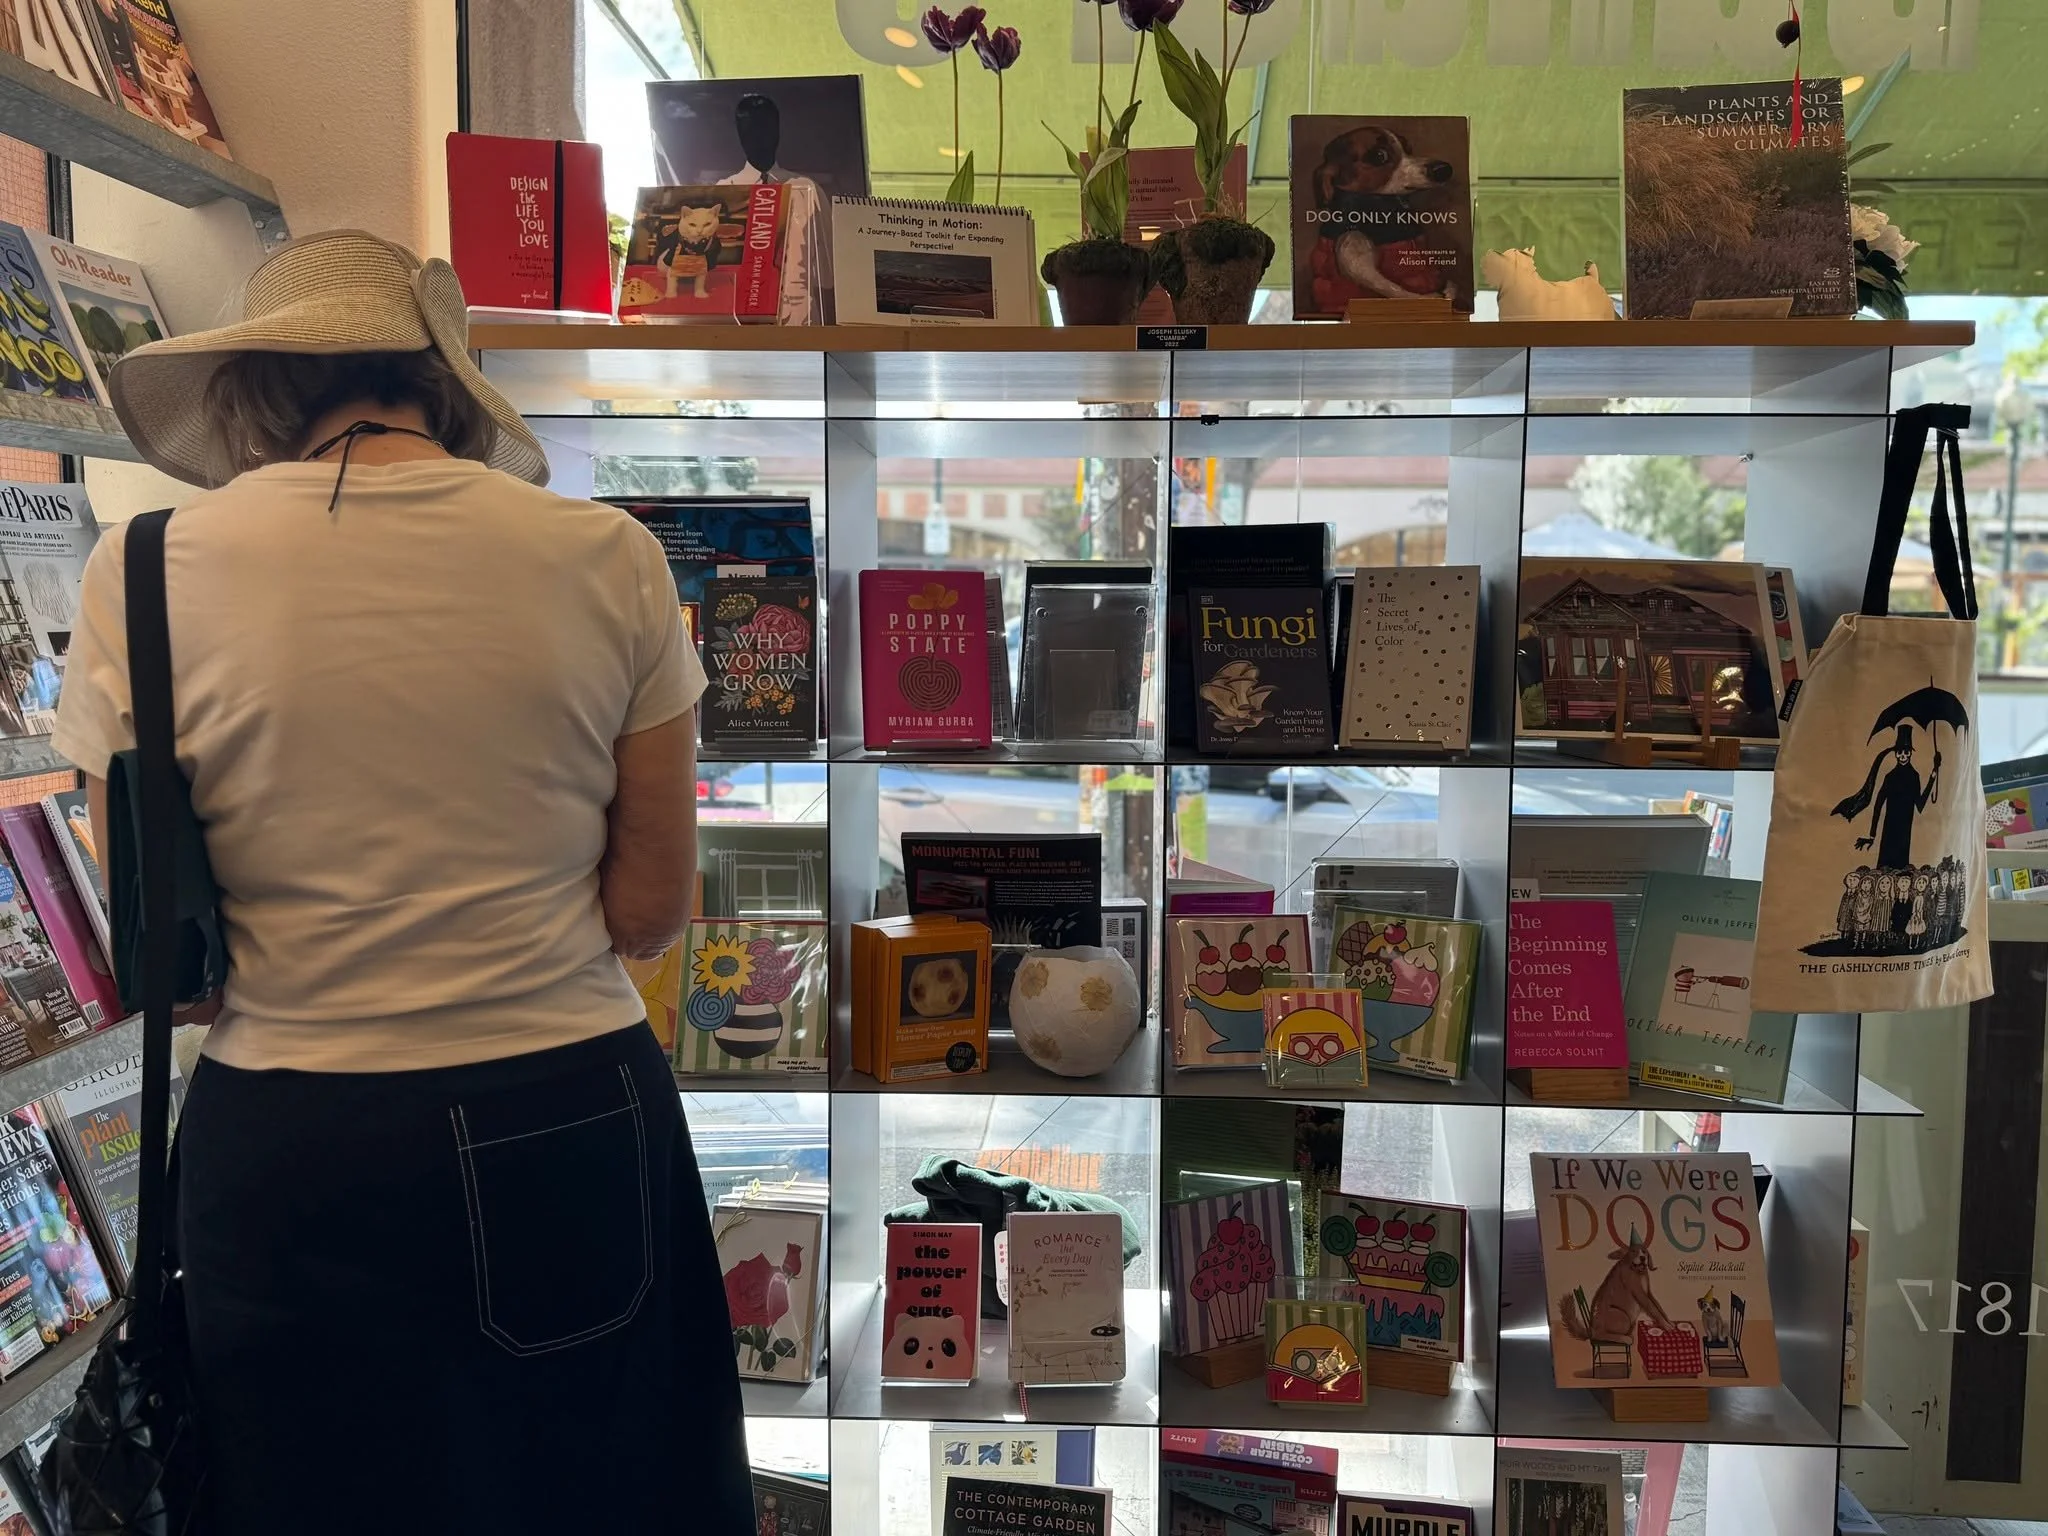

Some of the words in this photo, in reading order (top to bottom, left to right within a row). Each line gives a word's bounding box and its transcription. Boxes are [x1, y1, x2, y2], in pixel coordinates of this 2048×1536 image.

[1708, 95, 1779, 110] PLANTS
[1662, 109, 1785, 126] LANDSCAPES
[1802, 107, 1831, 119] OR
[510, 175, 548, 192] DESIGN
[519, 192, 536, 204] the
[515, 204, 540, 218] LIFE
[752, 187, 777, 250] CATLAND
[1306, 210, 1344, 224] DOG
[1348, 210, 1393, 225] ONLY
[1397, 211, 1458, 225] KNOWS
[519, 218, 545, 234] YOU
[878, 213, 924, 229] Thinking
[928, 215, 938, 228] in
[942, 217, 983, 230] Motion:
[519, 233, 550, 249] LOVE
[866, 227, 923, 239] Journey-Based
[926, 231, 951, 240] Toolkit
[953, 232, 966, 241] for
[968, 233, 1005, 246] Expanding
[910, 240, 954, 252] Perspective!
[50, 244, 78, 271] Oh
[76, 253, 132, 287] Reader
[752, 255, 764, 276] SARAH
[1399, 257, 1426, 265] Alison
[1428, 256, 1457, 266] Friend
[748, 277, 762, 307] ARCHER
[675, 521, 684, 529] of
[662, 530, 685, 538] essays
[666, 537, 699, 545] foremost
[683, 545, 716, 554] revealing
[686, 553, 695, 561] of
[695, 553, 708, 561] the
[1377, 592, 1397, 603] The
[1377, 607, 1409, 618] Secret
[888, 612, 967, 631] POPPY
[1200, 607, 1317, 646] Fungi
[1376, 621, 1404, 632] Lives
[1407, 620, 1420, 632] of
[732, 632, 791, 650] WHY
[889, 636, 967, 654] STATE
[1374, 636, 1404, 646] Color
[1203, 640, 1224, 652] for
[1223, 642, 1318, 659] Gardeners
[712, 653, 807, 671] WOMEN
[722, 673, 798, 691] GROW
[1283, 708, 1304, 716] Know
[1305, 707, 1324, 716] Your
[727, 719, 752, 727] Alice
[753, 719, 790, 728] Vincent
[888, 716, 933, 727] MYRIAM
[938, 716, 974, 727] GURBA
[1275, 717, 1302, 725] Garden
[1303, 717, 1324, 726] Fungi
[911, 844, 1005, 859] MONUMENTAL
[1009, 845, 1041, 859] FUN!
[1511, 889, 1532, 899] EW
[1509, 913, 1542, 929] The
[1681, 914, 1720, 927] OLIVER
[1508, 936, 1608, 956] Beginning
[1508, 959, 1572, 975] Comes
[1799, 964, 1828, 974] THE
[1832, 962, 1910, 974] GASHLYCRUMB
[1511, 982, 1564, 998] After
[1512, 1005, 1544, 1022] the
[1552, 1005, 1591, 1022] End
[927, 1030, 951, 1040] Paper
[952, 1027, 976, 1038] Lamp
[1514, 1030, 1535, 1038] Notes
[1554, 1030, 1576, 1038] World
[1577, 1030, 1585, 1038] of
[1586, 1030, 1612, 1039] Change
[1627, 1016, 1683, 1038] OLIVER
[1702, 1030, 1777, 1059] JEFFERS
[1514, 1048, 1563, 1057] REBECCA
[1566, 1048, 1604, 1057] SOLNIT
[94, 1111, 110, 1123] The
[80, 1111, 132, 1160] plant
[16, 1157, 52, 1183] Safer,
[94, 1162, 116, 1177] Flowers
[116, 1158, 127, 1168] and
[1548, 1157, 1581, 1190] If
[1590, 1158, 1643, 1191] We
[1651, 1158, 1739, 1192] Were
[111, 1211, 122, 1225] 50
[1550, 1193, 1751, 1253] DOGS
[114, 1221, 128, 1234] TO
[1034, 1232, 1102, 1249] ROMANCE
[914, 1245, 951, 1259] the
[1060, 1244, 1075, 1254] the
[1042, 1253, 1071, 1266] Every
[1072, 1252, 1093, 1266] Day
[896, 1266, 968, 1281] power
[1676, 1260, 1705, 1274] Sophie
[1708, 1260, 1745, 1272] Blackall
[1, 1270, 21, 1289] Trees
[920, 1284, 942, 1299] of
[12, 1292, 33, 1312] Spring
[11, 1303, 33, 1323] Kitchen
[906, 1305, 954, 1318] cute
[1169, 1433, 1197, 1445] KLUTZ
[1259, 1439, 1305, 1454] CABIN
[1249, 1447, 1280, 1459] BEAR
[1281, 1453, 1313, 1465] COZY
[1522, 1461, 1556, 1471] WOODS
[1557, 1462, 1578, 1472] AND
[1300, 1487, 1329, 1497] KLUTZ
[956, 1490, 983, 1503] THE
[987, 1493, 1096, 1516] CONTEMPORARY
[954, 1507, 1027, 1526] COTTAGE
[1032, 1515, 1096, 1534] GARDEN
[1351, 1514, 1461, 1536] MURDLE
